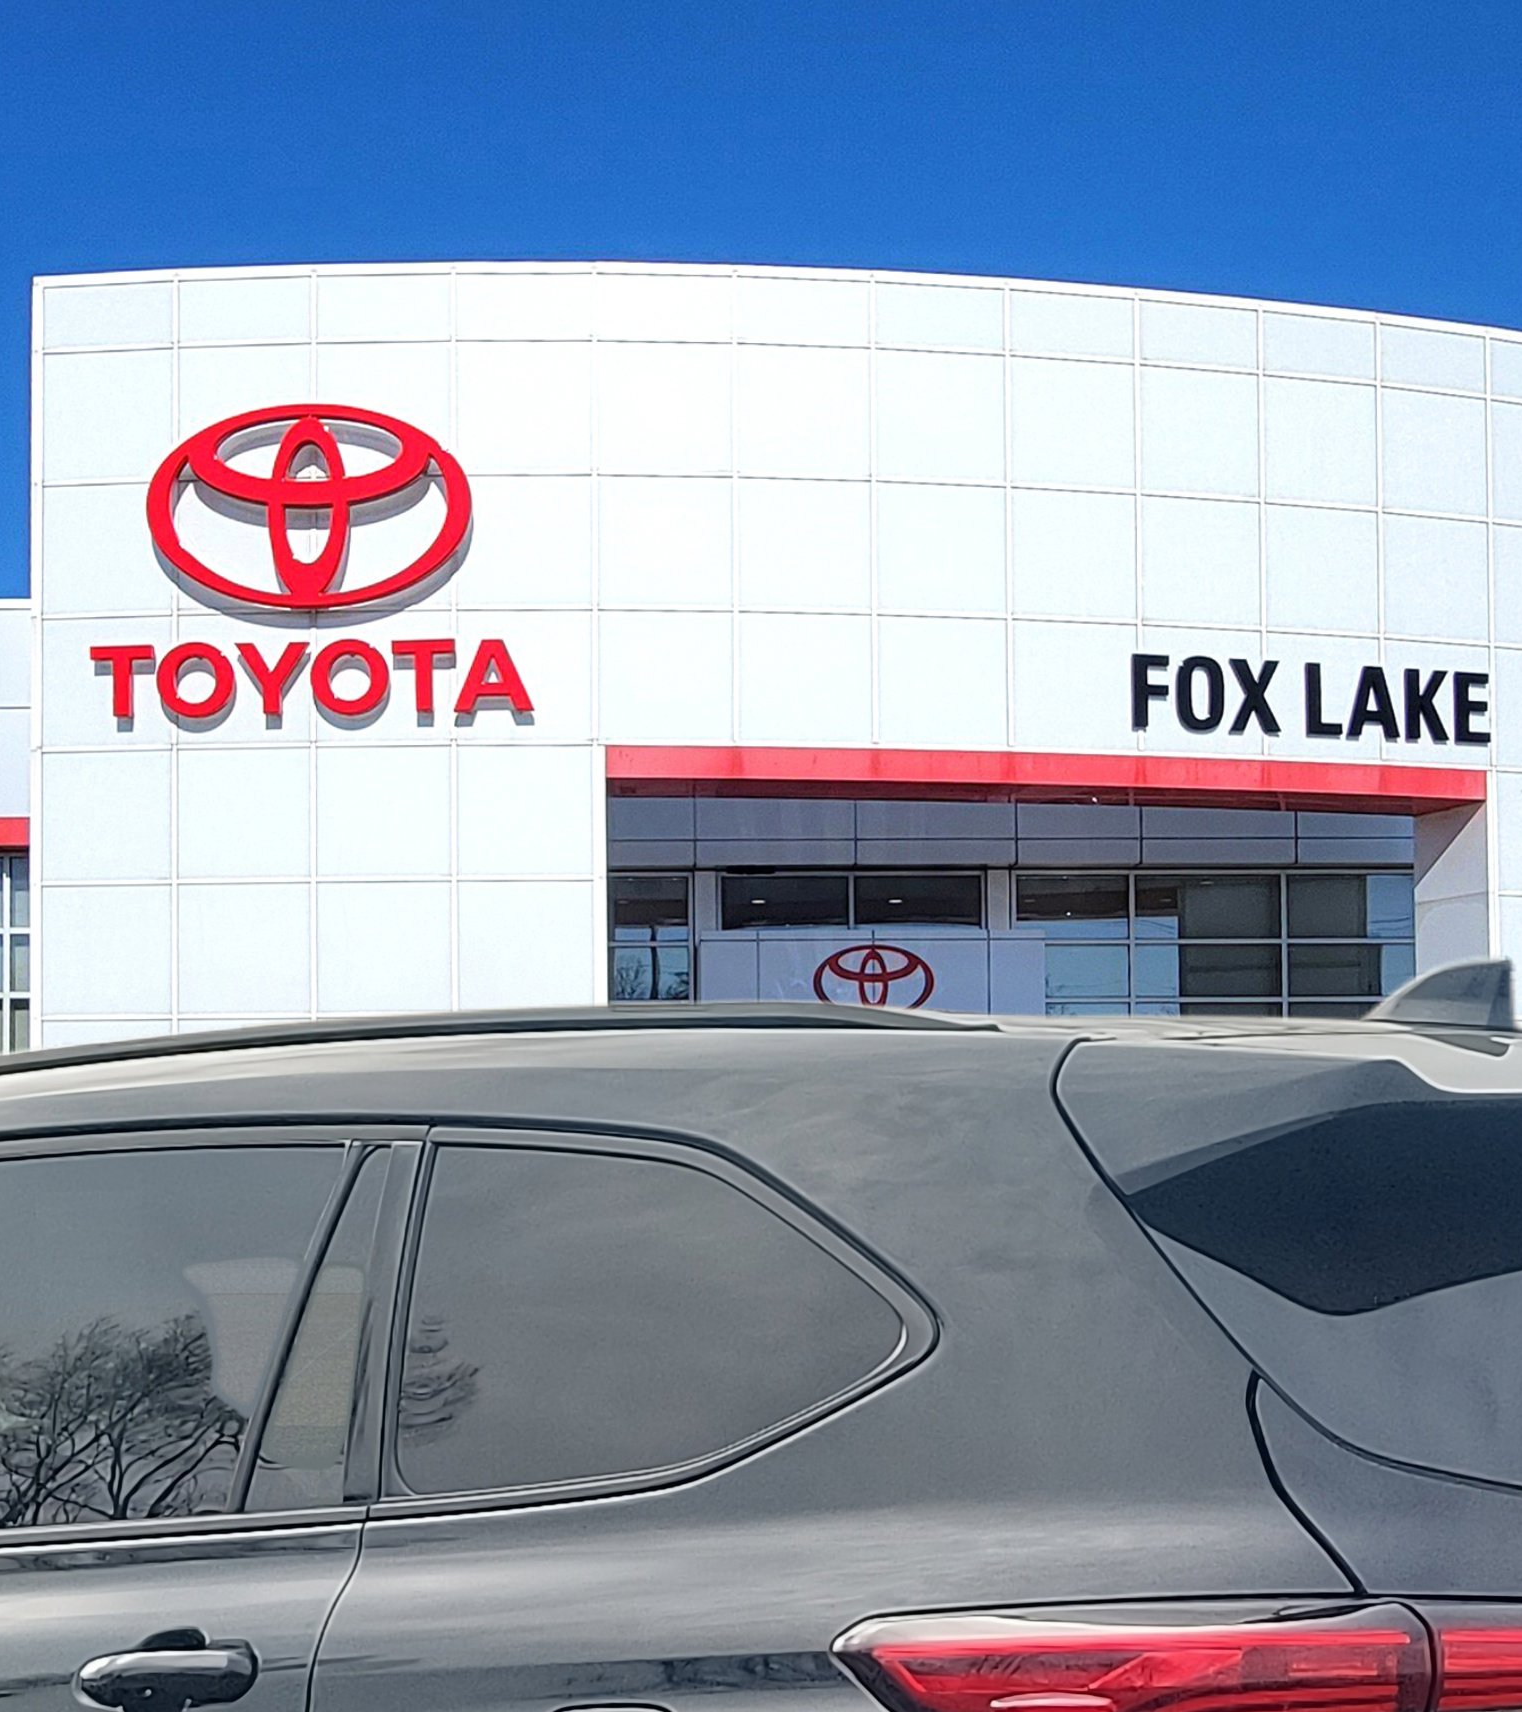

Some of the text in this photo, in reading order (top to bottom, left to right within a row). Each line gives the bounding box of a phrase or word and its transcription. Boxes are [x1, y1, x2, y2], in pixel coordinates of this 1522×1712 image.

[90, 639, 535, 724] TOYOTA
[1131, 653, 1491, 745] FOX LAKE
